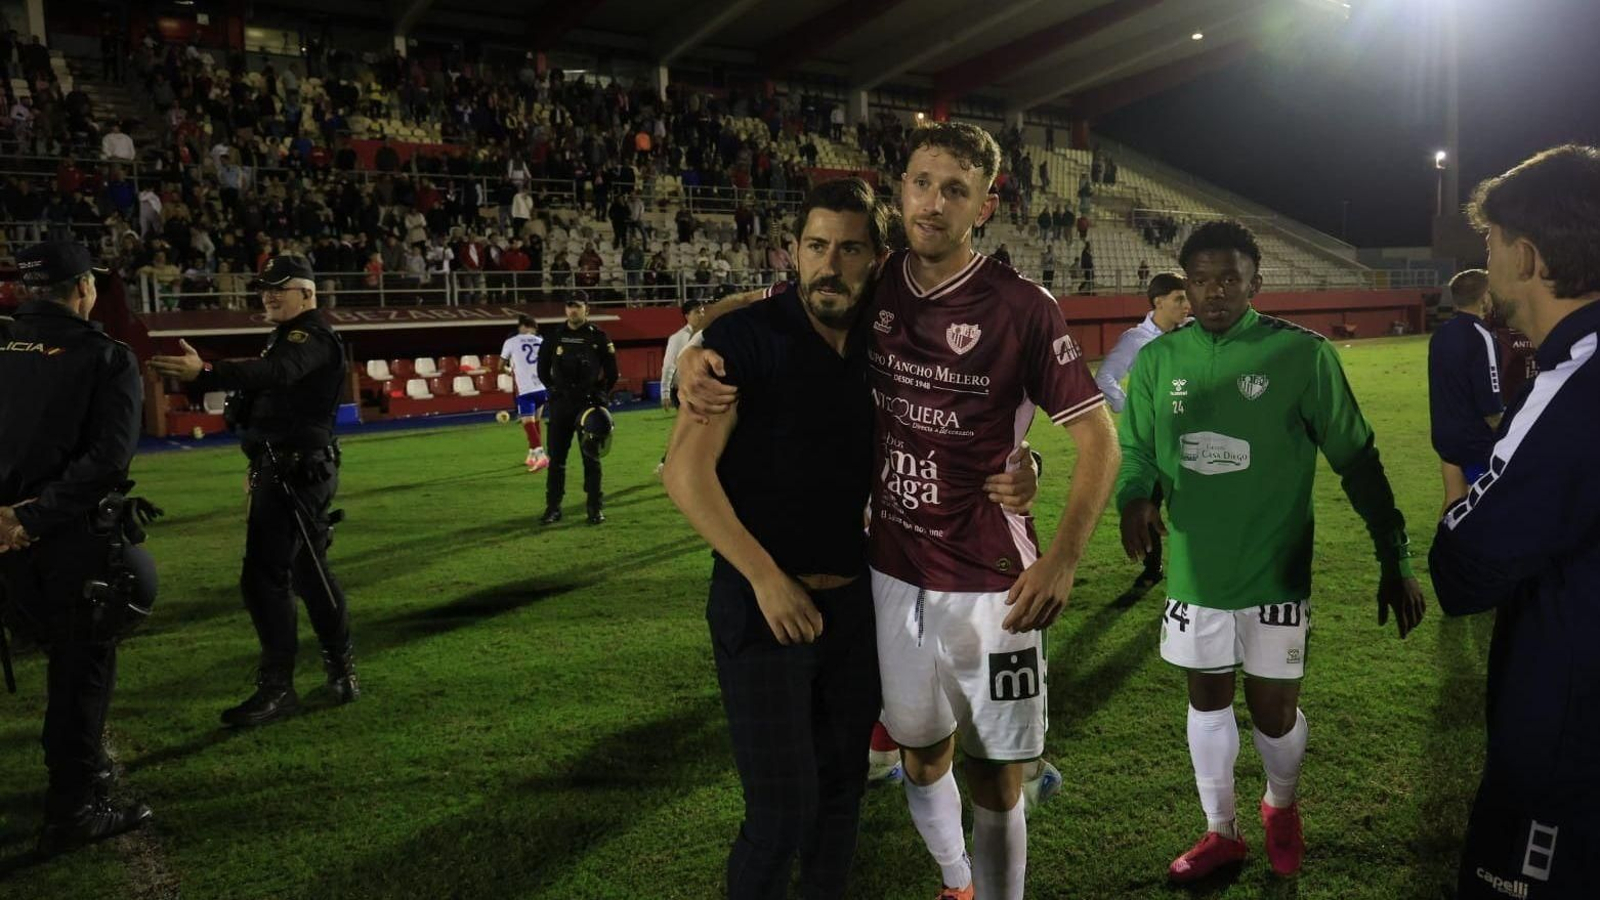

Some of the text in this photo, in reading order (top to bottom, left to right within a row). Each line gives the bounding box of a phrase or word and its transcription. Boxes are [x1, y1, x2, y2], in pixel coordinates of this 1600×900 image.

[894, 374, 931, 389] DESDE 1948
[935, 365, 991, 387] MELERO
[1172, 400, 1184, 414] 24
[1476, 866, 1529, 898] capelli
